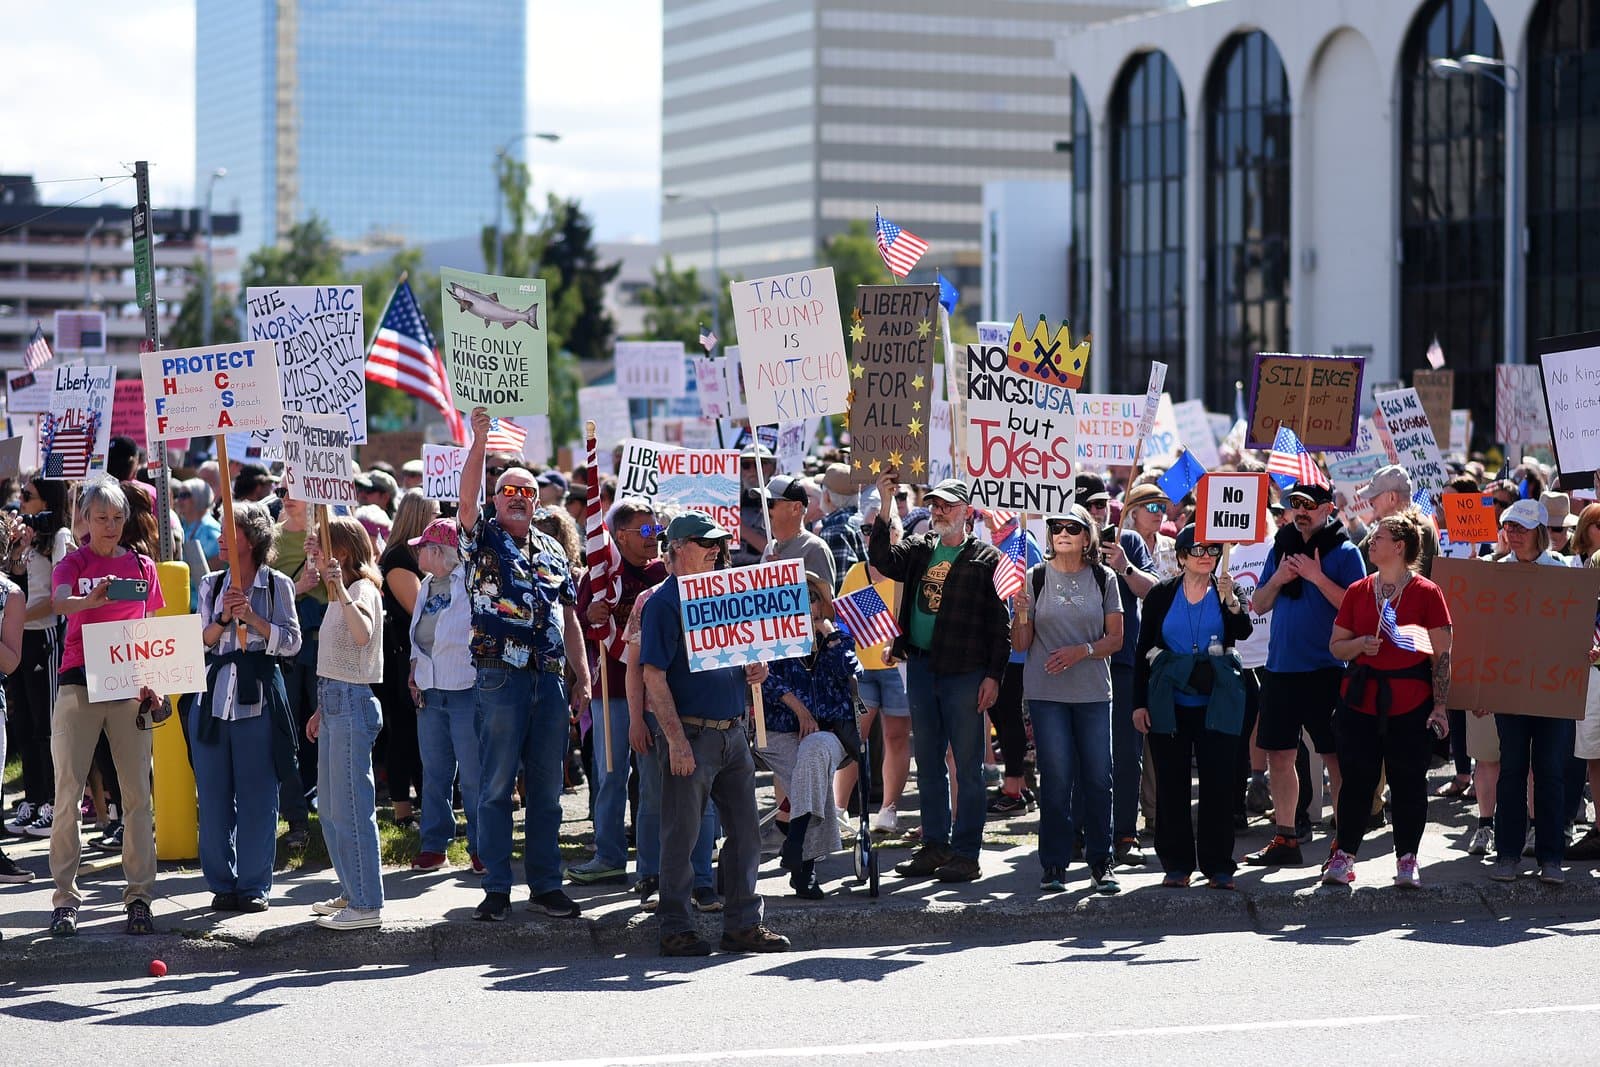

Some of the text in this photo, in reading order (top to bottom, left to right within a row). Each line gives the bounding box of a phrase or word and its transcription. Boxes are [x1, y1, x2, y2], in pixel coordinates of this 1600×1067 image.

[750, 275, 812, 303] TACO
[247, 287, 355, 318] THE ARC
[861, 291, 936, 317] LIBERTY
[251, 304, 311, 341] MORAL
[747, 300, 824, 332] TRUMP
[878, 320, 914, 337] AND
[283, 331, 318, 366] BEND
[308, 311, 361, 347] ITSELF
[451, 331, 522, 356] THE ONLY
[784, 333, 800, 349] IS
[860, 339, 927, 364] JUSTICE
[162, 349, 256, 377] PROTECT
[283, 357, 328, 398] MUST
[320, 335, 363, 376] PULL
[453, 348, 528, 372] KINGS WE
[758, 351, 843, 390] NOTCHO
[967, 345, 1008, 374] NO
[55, 366, 95, 393] Liberty
[94, 365, 112, 389] and
[214, 372, 256, 391] Corpus
[453, 365, 529, 388] WANT ARE
[867, 371, 908, 399] FOR
[1265, 365, 1354, 388] SILENCE
[1552, 368, 1568, 386] No
[305, 368, 364, 414] TOWARD
[455, 382, 524, 404] SALMON.
[774, 385, 829, 419] KING
[1034, 382, 1074, 416] USA
[1283, 392, 1297, 406] is
[1308, 391, 1330, 406] not
[1402, 395, 1417, 409] ARE
[864, 402, 902, 428] ALL
[1555, 400, 1569, 413] No
[157, 416, 201, 435] Freedom
[281, 414, 304, 436] STOP
[303, 425, 350, 449] PRETENDING
[1008, 408, 1054, 440] but
[1388, 421, 1400, 435] SO
[1560, 427, 1575, 441] No
[853, 435, 877, 453] NO
[1421, 431, 1435, 446] ALL
[282, 440, 347, 477] YOUR RACISM
[426, 449, 461, 477] LOVE
[658, 454, 740, 475] WE DON'T
[1411, 447, 1427, 461] THE
[285, 466, 357, 501] IS PATRIOTISM
[968, 478, 1073, 513] APLENTY
[1222, 486, 1243, 504] No
[1457, 498, 1475, 510] NO
[1213, 510, 1250, 529] King
[1456, 515, 1483, 527] WAR
[682, 563, 800, 602] THIS IS WHAT
[686, 588, 802, 627] DEMOCRACY
[1448, 575, 1582, 620] Resist
[122, 622, 149, 641] NO
[689, 612, 808, 653] LOOKS LIKE
[109, 638, 176, 665] KINGS
